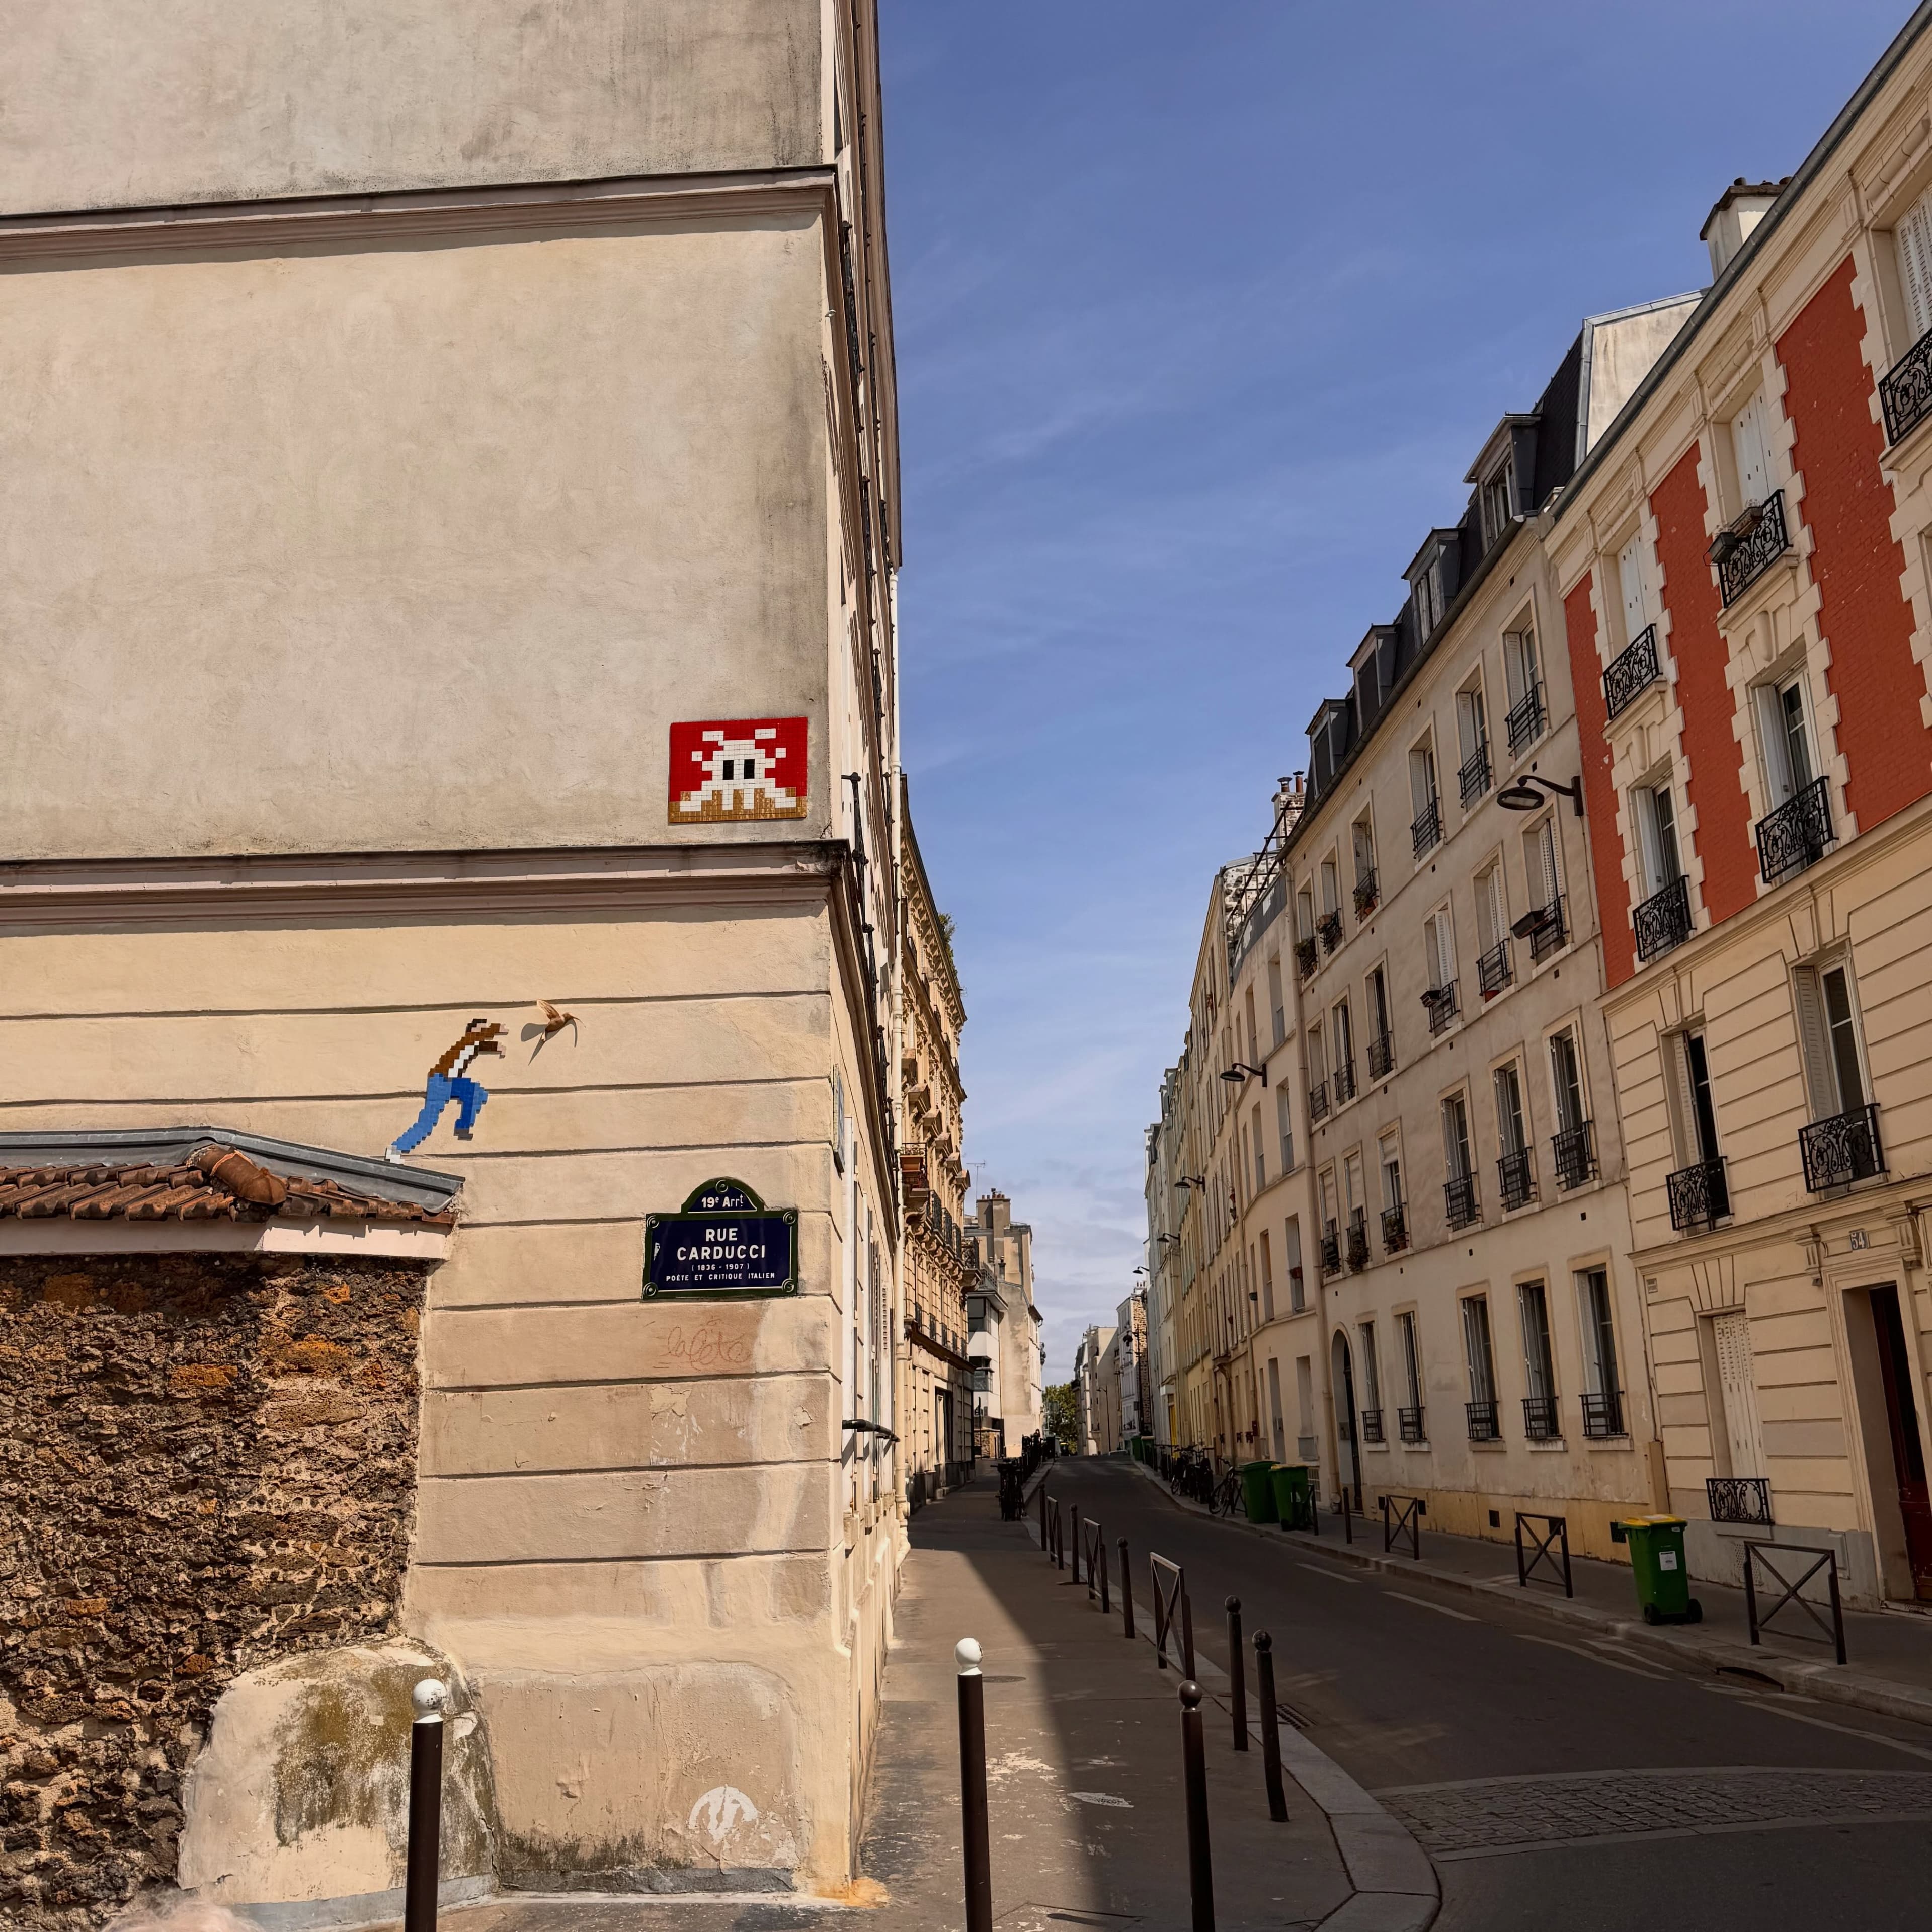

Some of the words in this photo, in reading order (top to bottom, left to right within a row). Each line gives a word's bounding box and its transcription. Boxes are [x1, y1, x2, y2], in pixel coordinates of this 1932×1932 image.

[701, 1196, 719, 1208] 19e
[705, 1228, 738, 1242] RUE
[1851, 1232, 1865, 1249] 54
[677, 1244, 765, 1261] CARDUCCI
